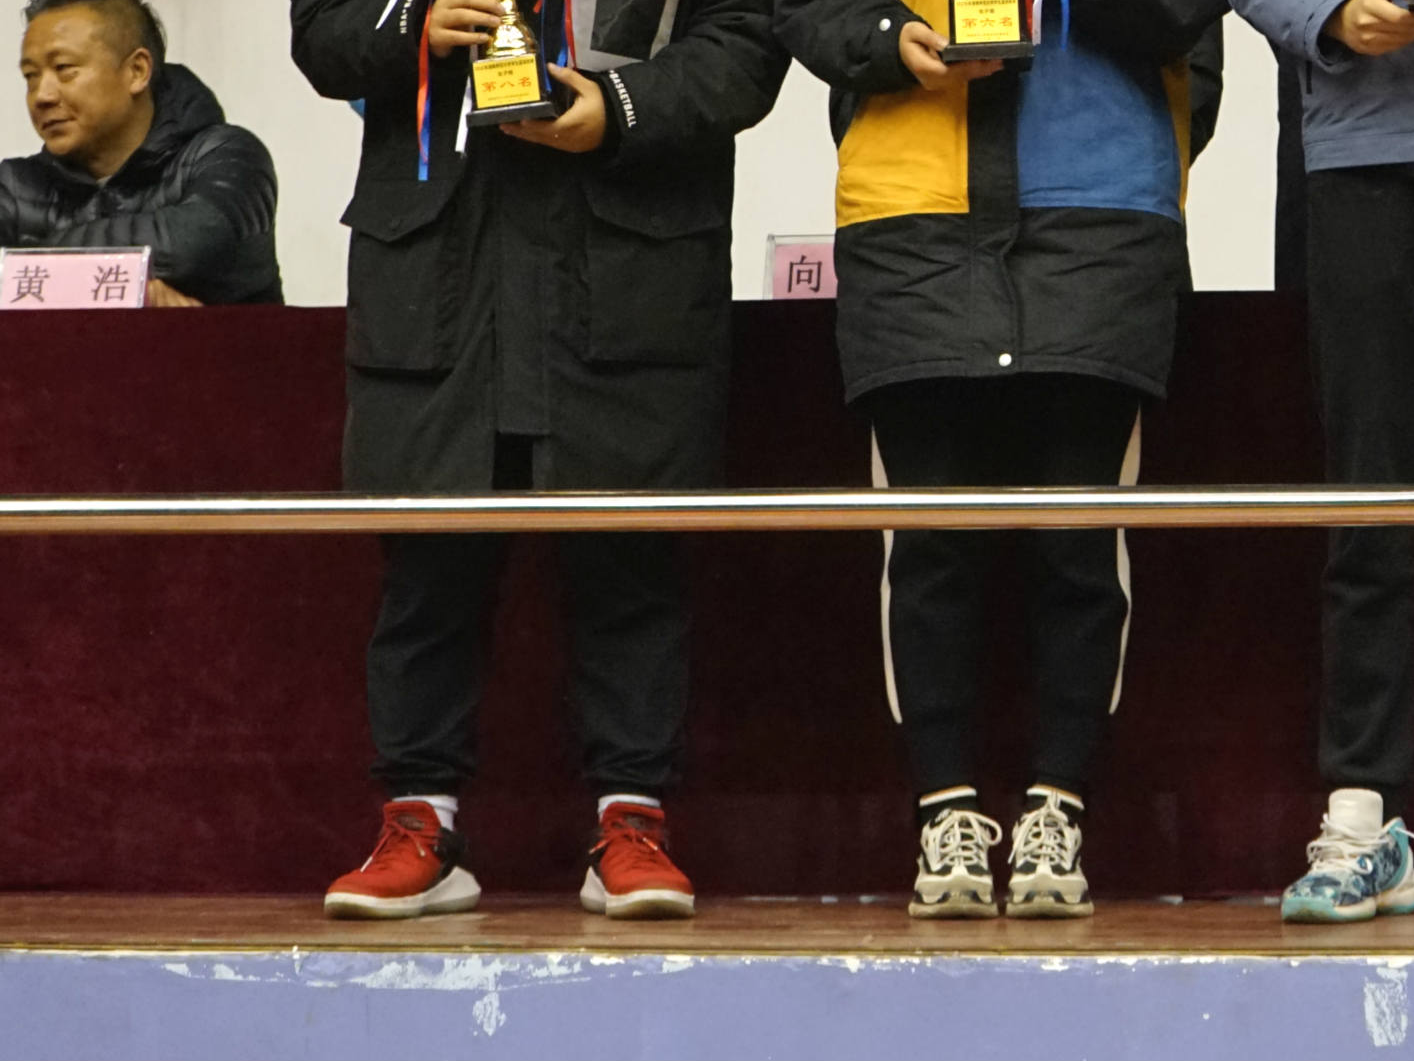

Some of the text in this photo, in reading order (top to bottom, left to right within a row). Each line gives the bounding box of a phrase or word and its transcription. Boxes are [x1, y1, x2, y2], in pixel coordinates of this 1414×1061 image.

[961, 16, 1013, 29] 第六名
[481, 76, 532, 93] 第八名
[786, 253, 824, 294] 向
